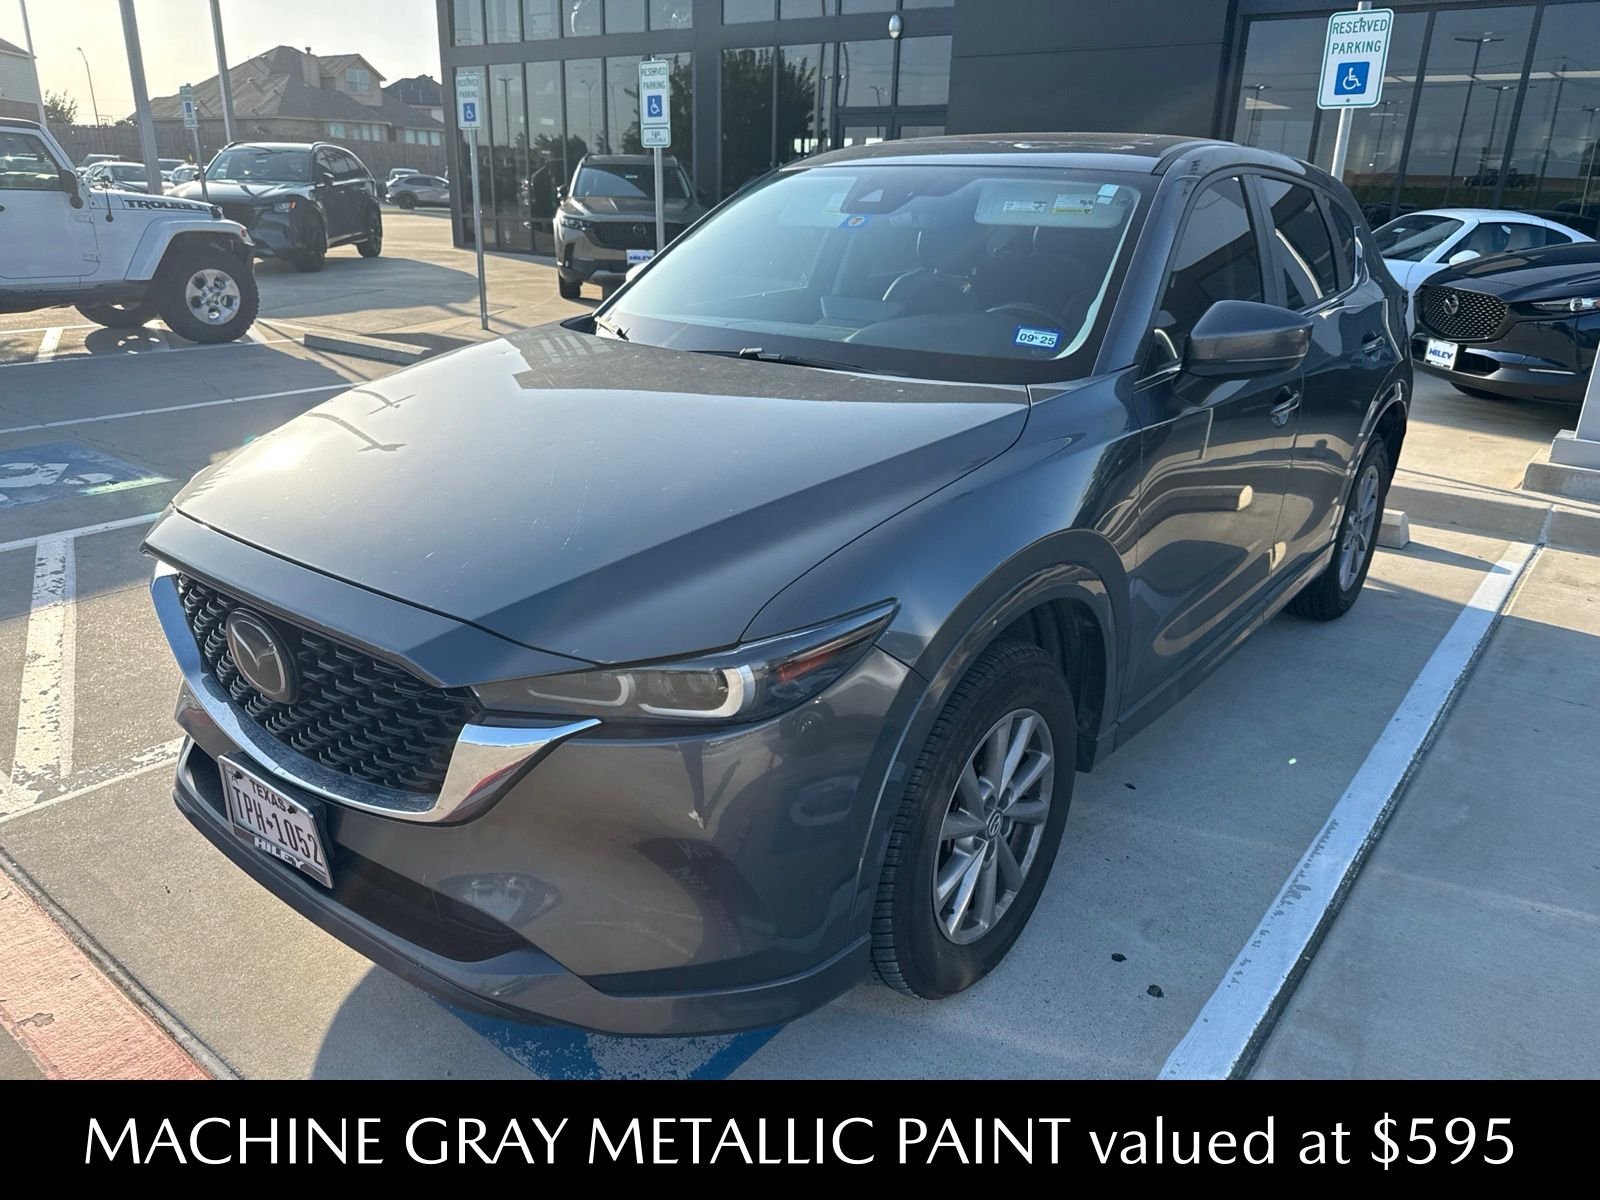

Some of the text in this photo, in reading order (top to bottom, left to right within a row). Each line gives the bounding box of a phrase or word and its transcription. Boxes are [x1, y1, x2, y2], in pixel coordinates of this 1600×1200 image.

[1332, 19, 1388, 35] RESERVED
[1331, 40, 1382, 55] PARKING
[641, 67, 667, 76] RESERVED
[642, 81, 666, 90] PARKING
[1429, 348, 1454, 360] HILEY
[249, 779, 287, 812] TEXAS
[253, 836, 305, 869] HILEY
